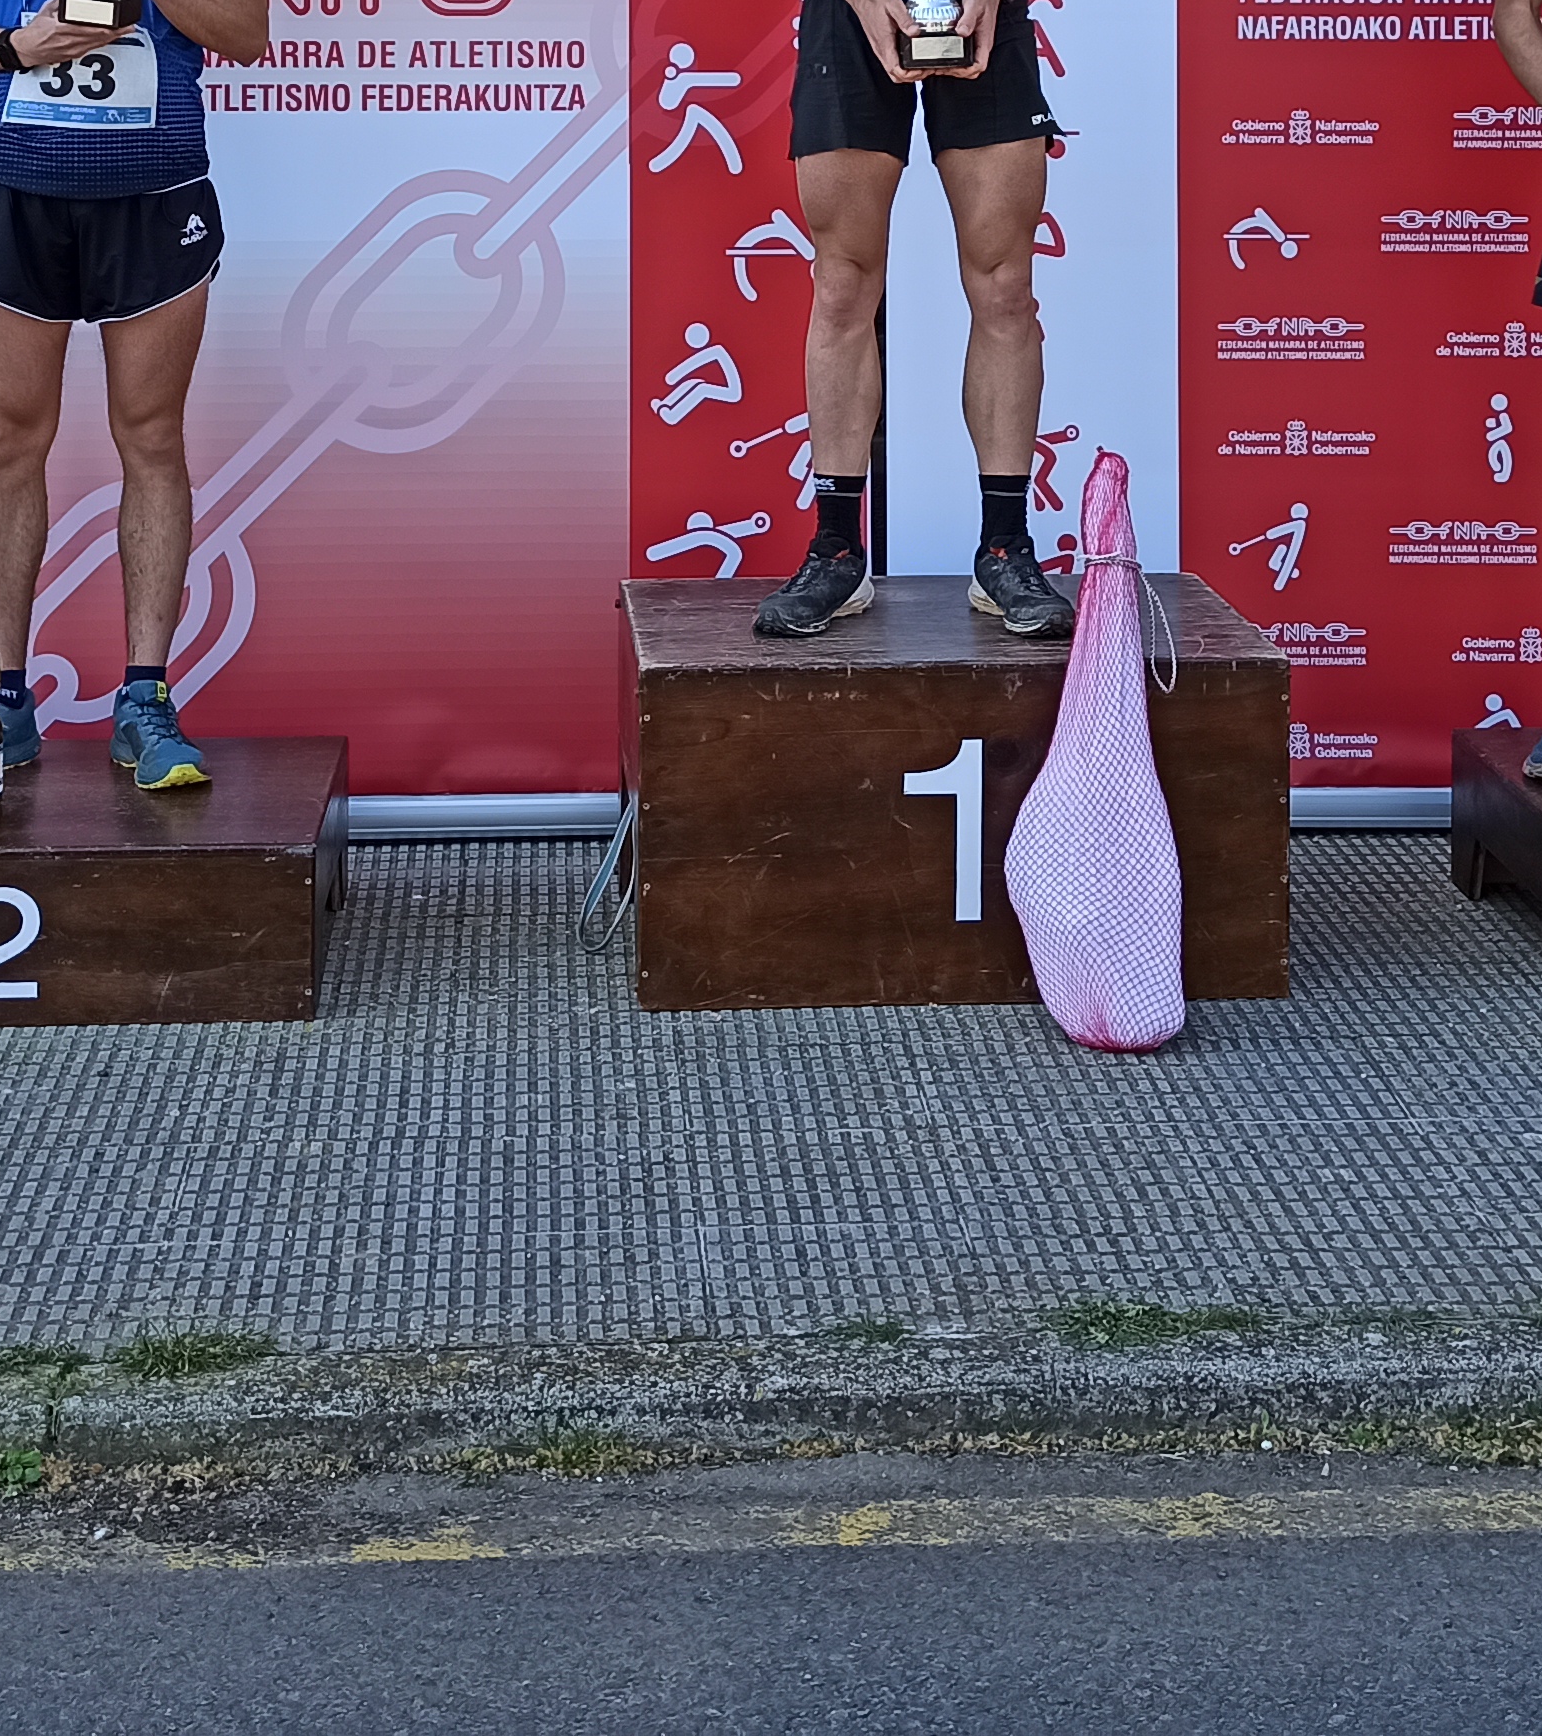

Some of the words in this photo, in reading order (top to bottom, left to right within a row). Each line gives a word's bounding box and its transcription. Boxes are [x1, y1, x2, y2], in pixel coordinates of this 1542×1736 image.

[1238, 16, 1401, 40] NAFARROAKO
[358, 41, 396, 68] DE
[409, 41, 585, 68] ATLETISMO
[40, 54, 116, 100] 33
[206, 84, 350, 111] TLETISMO
[361, 84, 585, 111] FEDERAKUNTZA
[1232, 120, 1285, 131] Gobierno
[1316, 120, 1379, 131] Nafarroako
[1221, 133, 1236, 144] de
[1239, 133, 1285, 144] Navarra
[1316, 133, 1373, 144] Gobernua
[1454, 128, 1502, 138] FEDERACIÓN
[1505, 130, 1542, 138] NAVARRA
[1453, 141, 1502, 149] NAFARROAKO
[1503, 141, 1542, 149] ATLETISMO
[1381, 232, 1430, 241] FEDERACIÓN
[1381, 244, 1429, 252] NAFARROAKO
[1431, 244, 1471, 252] ATLETISMO
[1473, 244, 1529, 252] FEDERAKUNTZA
[1446, 332, 1500, 343] Gobierno
[1218, 339, 1266, 349] FEDERACIÓN
[1268, 341, 1306, 349] NAVARRA
[1308, 341, 1318, 349] DE
[1320, 341, 1364, 349] ATLETISMO
[1217, 351, 1266, 360] NAFARROAKO
[1267, 351, 1307, 360] ATLETISMO
[1309, 351, 1365, 360] FEDERAKUNTZA
[1436, 345, 1451, 356] de
[1453, 346, 1500, 356] Navarra
[1228, 430, 1281, 441] Gobierno
[1312, 430, 1376, 441] Nafarroako
[1218, 444, 1232, 455] de
[1235, 444, 1281, 455] Navarra
[1312, 444, 1369, 455] Gobernua
[1389, 543, 1438, 553] FEDERACIÓN
[1440, 545, 1478, 553] NAVARRA
[1480, 545, 1490, 553] DE
[1493, 545, 1537, 553] ATLETISMO
[1389, 555, 1438, 564] NAFARROAKO
[1439, 555, 1480, 564] ATLETISMO
[1481, 555, 1537, 564] FEDERAKUNTZA
[1462, 638, 1515, 649] Gobierno
[1452, 651, 1467, 662] de
[1470, 651, 1515, 662] Navarra
[1314, 733, 1378, 744] Nafarroako
[1314, 747, 1373, 758] Gobernua
[904, 739, 983, 921] 1
